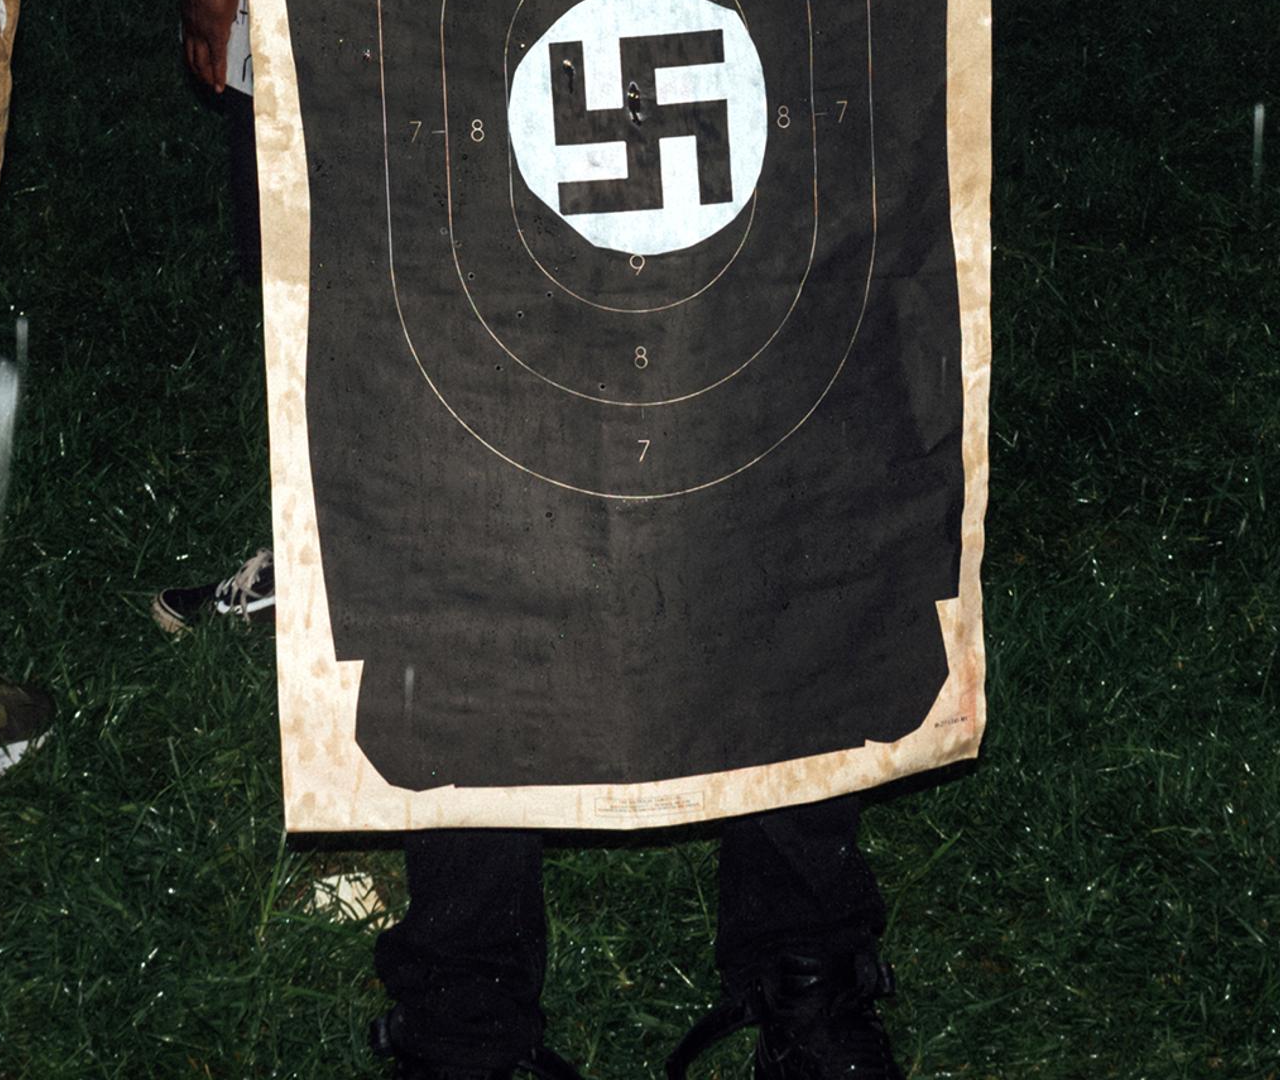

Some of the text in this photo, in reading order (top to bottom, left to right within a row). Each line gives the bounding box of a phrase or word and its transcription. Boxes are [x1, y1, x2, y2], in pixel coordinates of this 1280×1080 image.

[776, 105, 791, 129] 8
[836, 100, 848, 123] 7
[408, 120, 423, 143] 7
[470, 119, 485, 142] 8
[629, 254, 646, 276] 9
[634, 345, 649, 369] 8
[637, 439, 651, 463] 7
